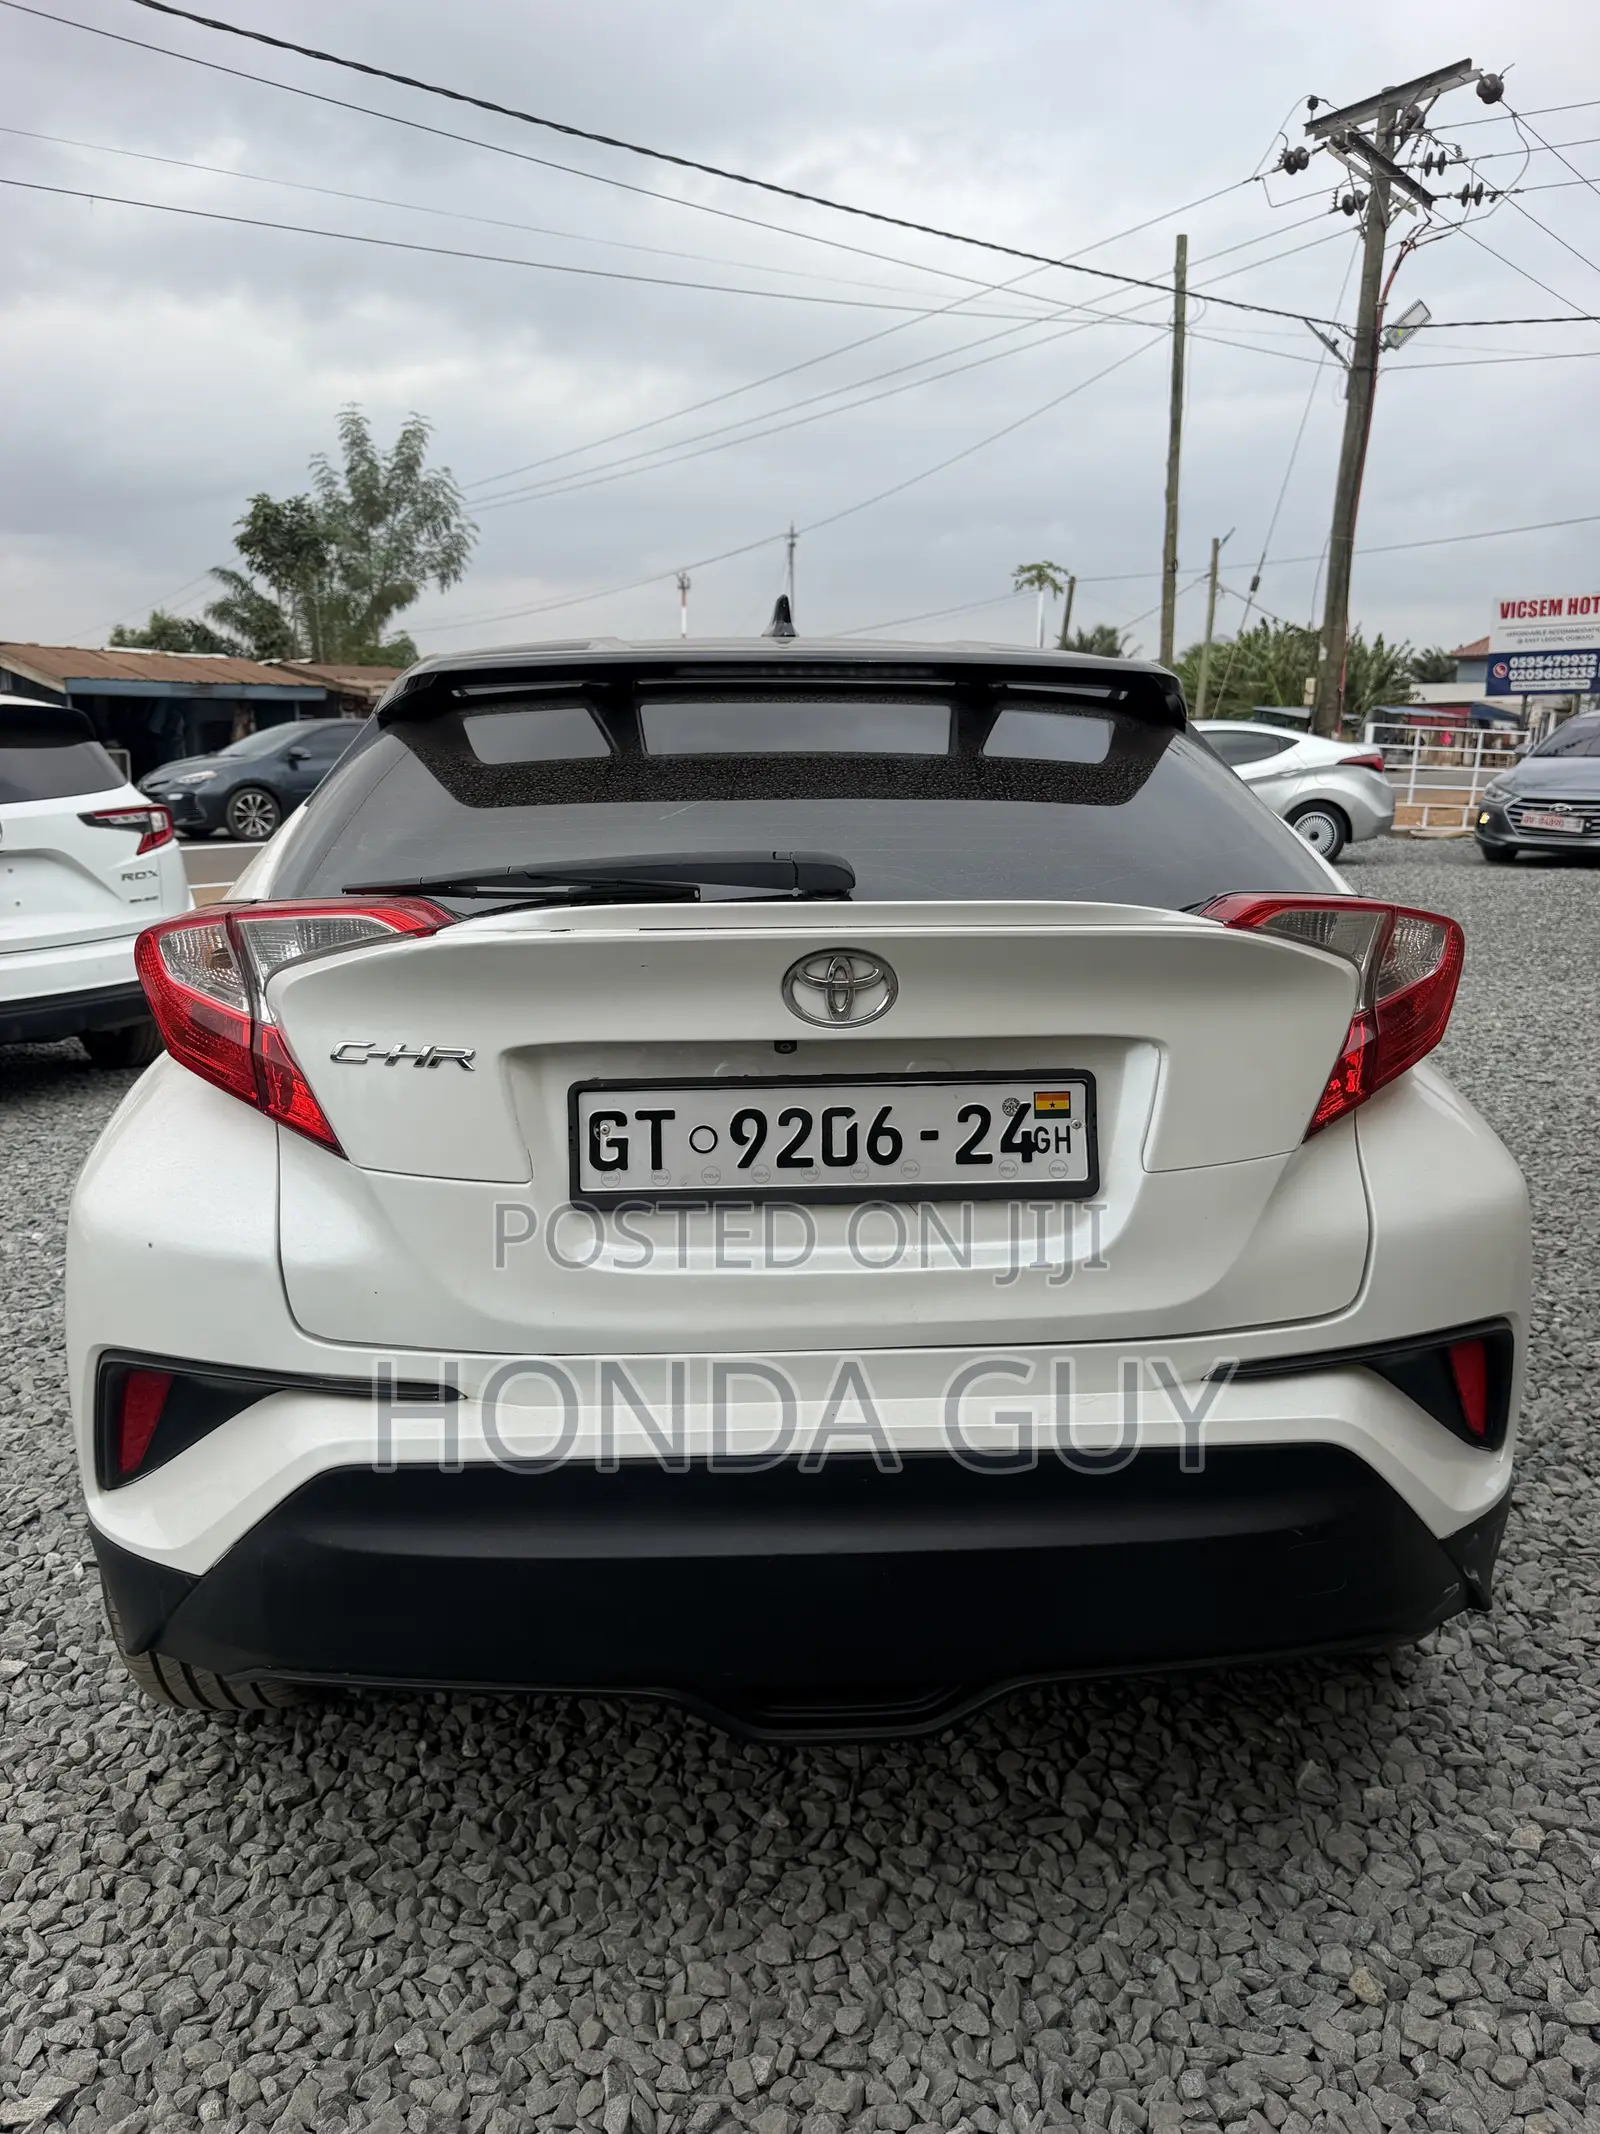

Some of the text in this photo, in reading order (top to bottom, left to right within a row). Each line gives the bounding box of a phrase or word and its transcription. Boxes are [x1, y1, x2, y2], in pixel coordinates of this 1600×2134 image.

[1500, 599, 1563, 620] VICSEM
[121, 869, 158, 881] RDX
[330, 1040, 476, 1071] C-HR
[588, 1109, 676, 1171] GT
[1034, 1126, 1072, 1154] GH
